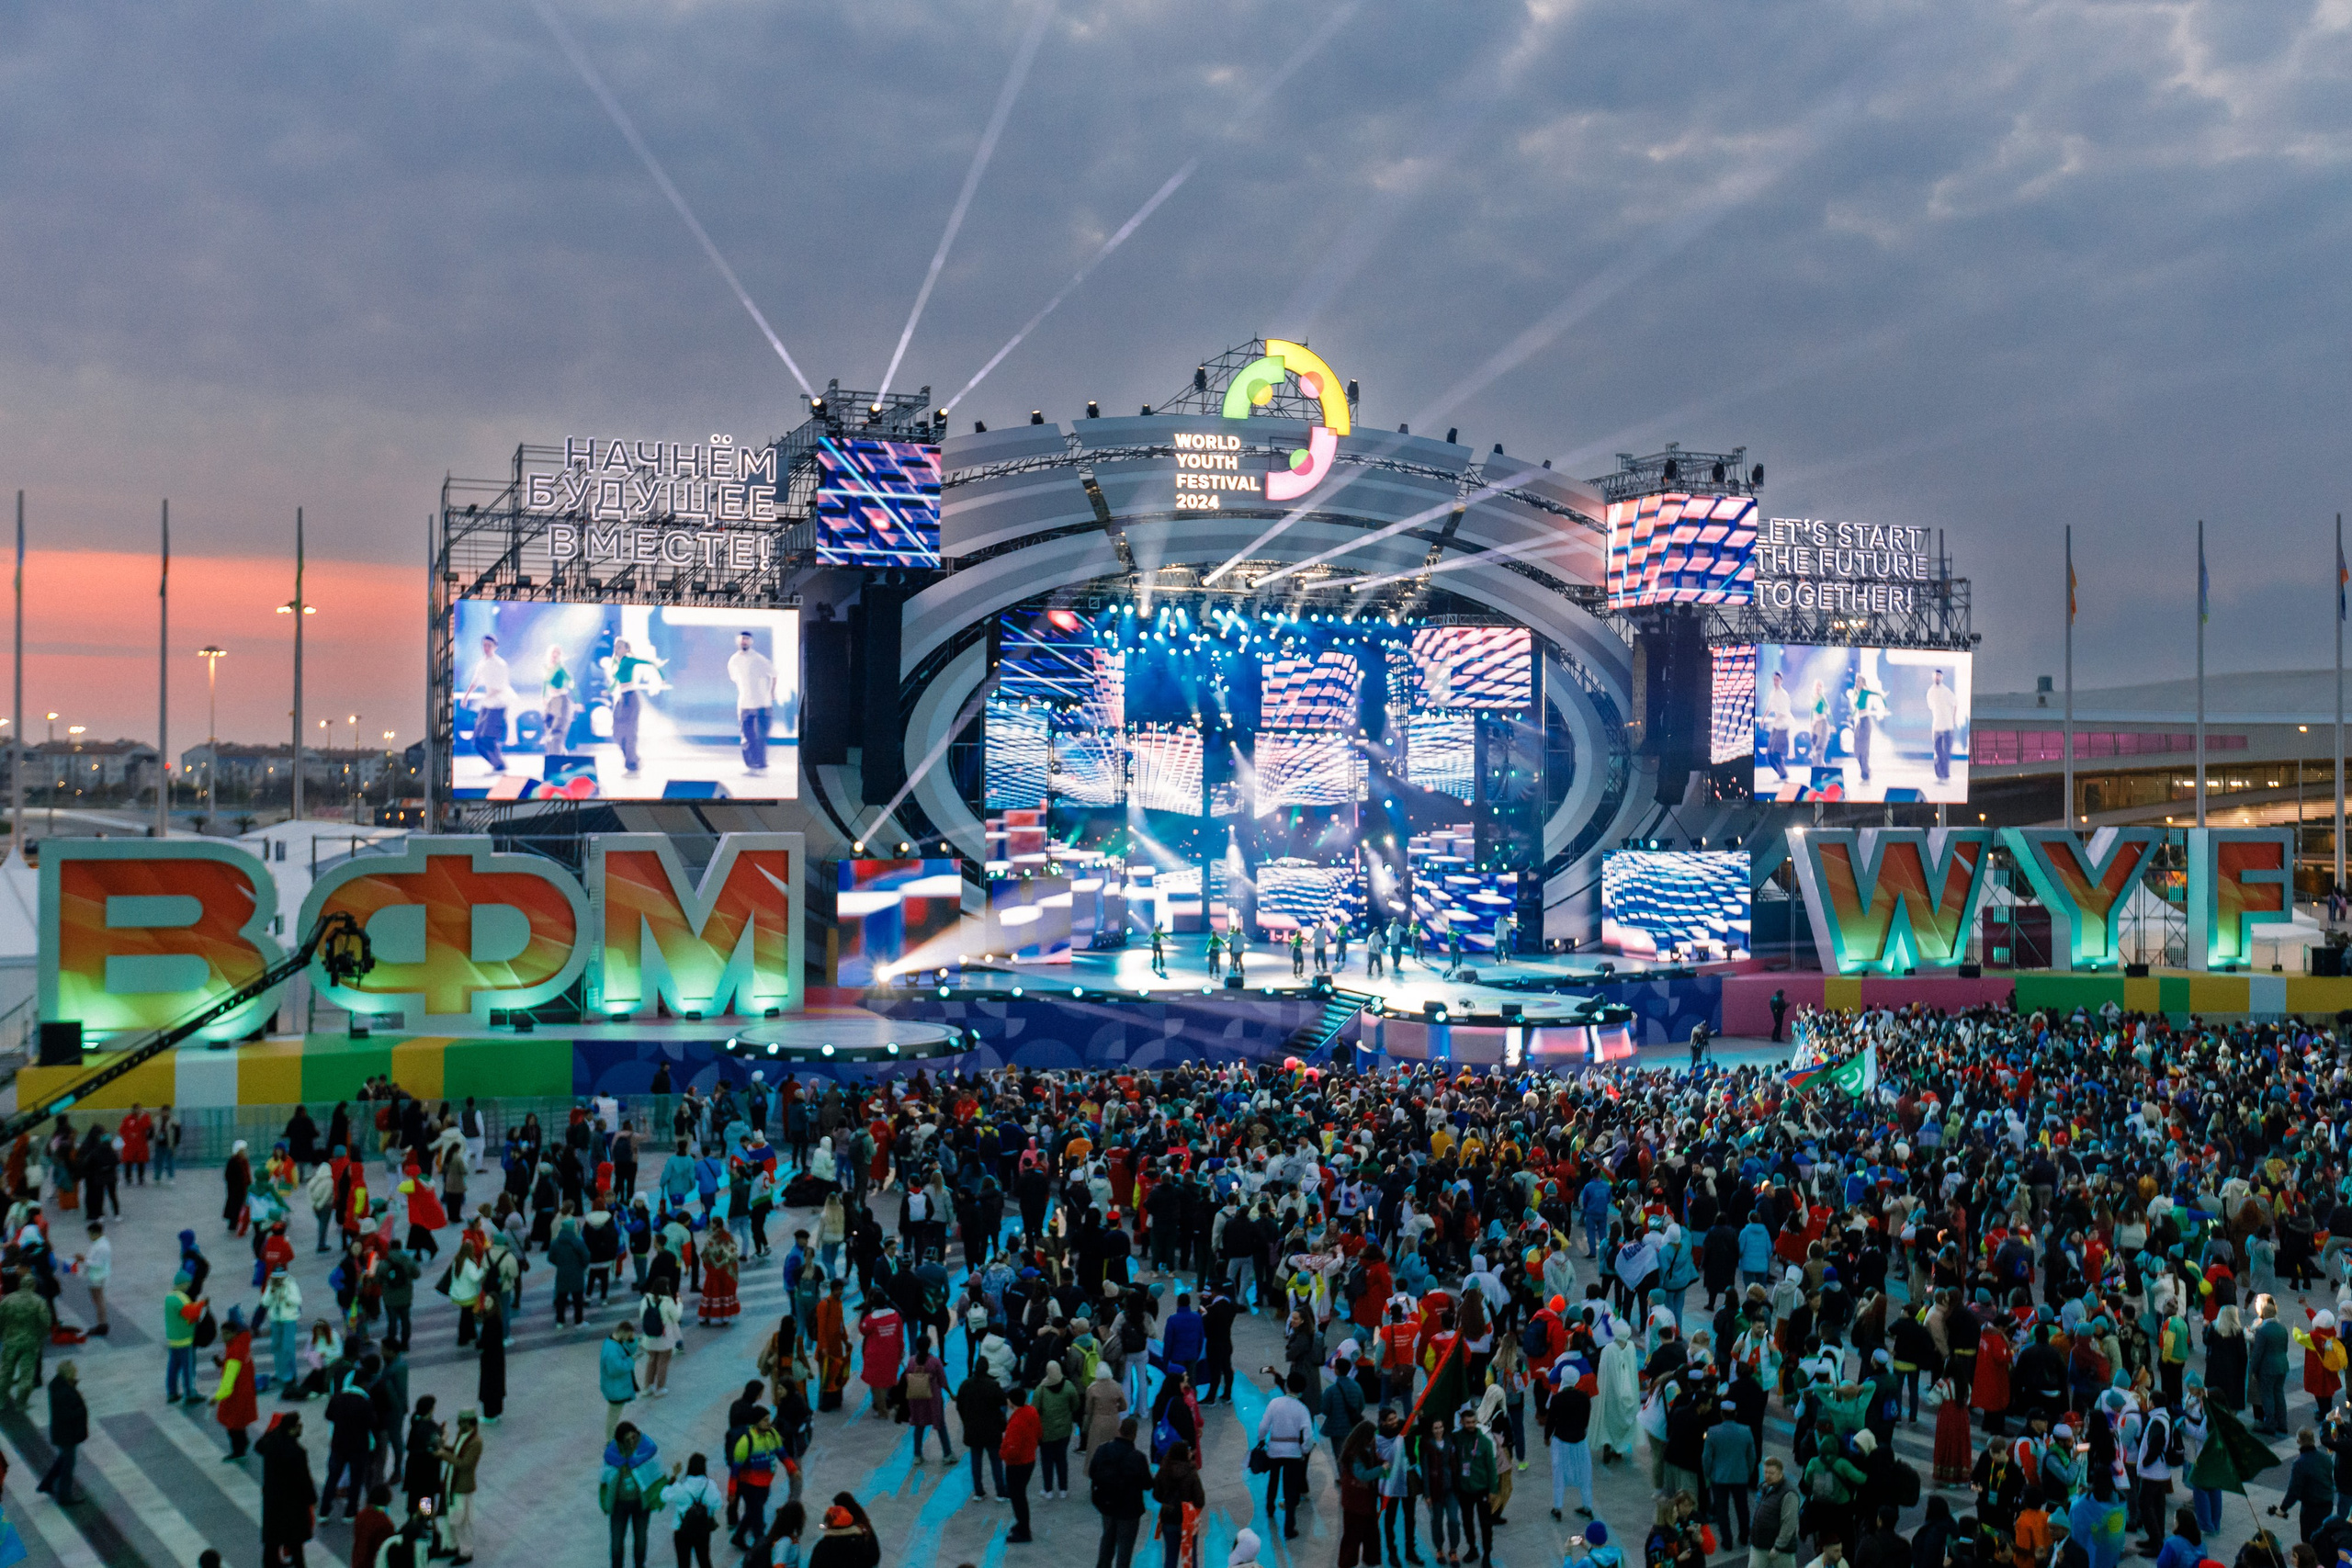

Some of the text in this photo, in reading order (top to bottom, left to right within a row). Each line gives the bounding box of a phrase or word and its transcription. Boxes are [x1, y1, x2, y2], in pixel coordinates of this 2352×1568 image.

[564, 433, 777, 484] НАЧНЁМ
[1174, 433, 1241, 450] WORLD
[1175, 454, 1238, 470] YOUTH
[526, 472, 777, 526] БУДУЩЕЕ
[1176, 474, 1261, 491] FESTIVAL
[1175, 493, 1220, 510] 2024
[548, 523, 772, 572] ВМЕСТЕ!
[1838, 521, 1923, 552] START
[1755, 544, 1929, 581] THE FUTURE
[1754, 580, 1914, 614] TOGETHER!
[1785, 826, 2294, 976] WYF
[38, 831, 806, 1049] ВФМ
